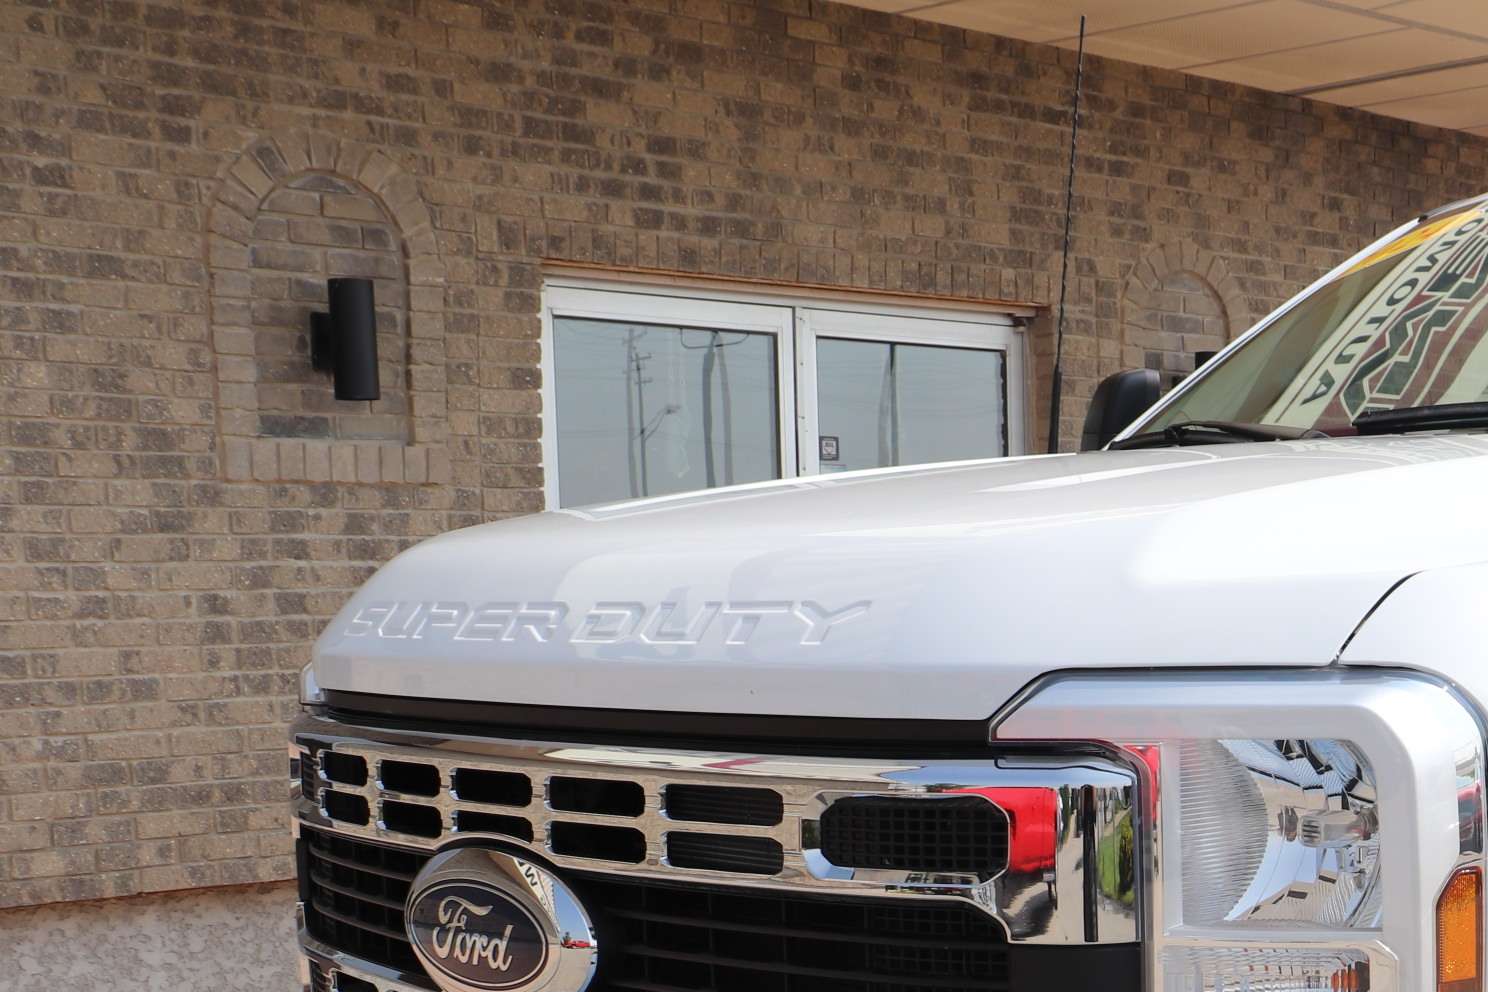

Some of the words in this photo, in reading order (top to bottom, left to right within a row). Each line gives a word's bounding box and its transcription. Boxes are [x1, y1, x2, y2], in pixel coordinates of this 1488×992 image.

[343, 600, 570, 643] SUPER
[569, 599, 874, 646] DUTY
[432, 895, 514, 972] Ford
